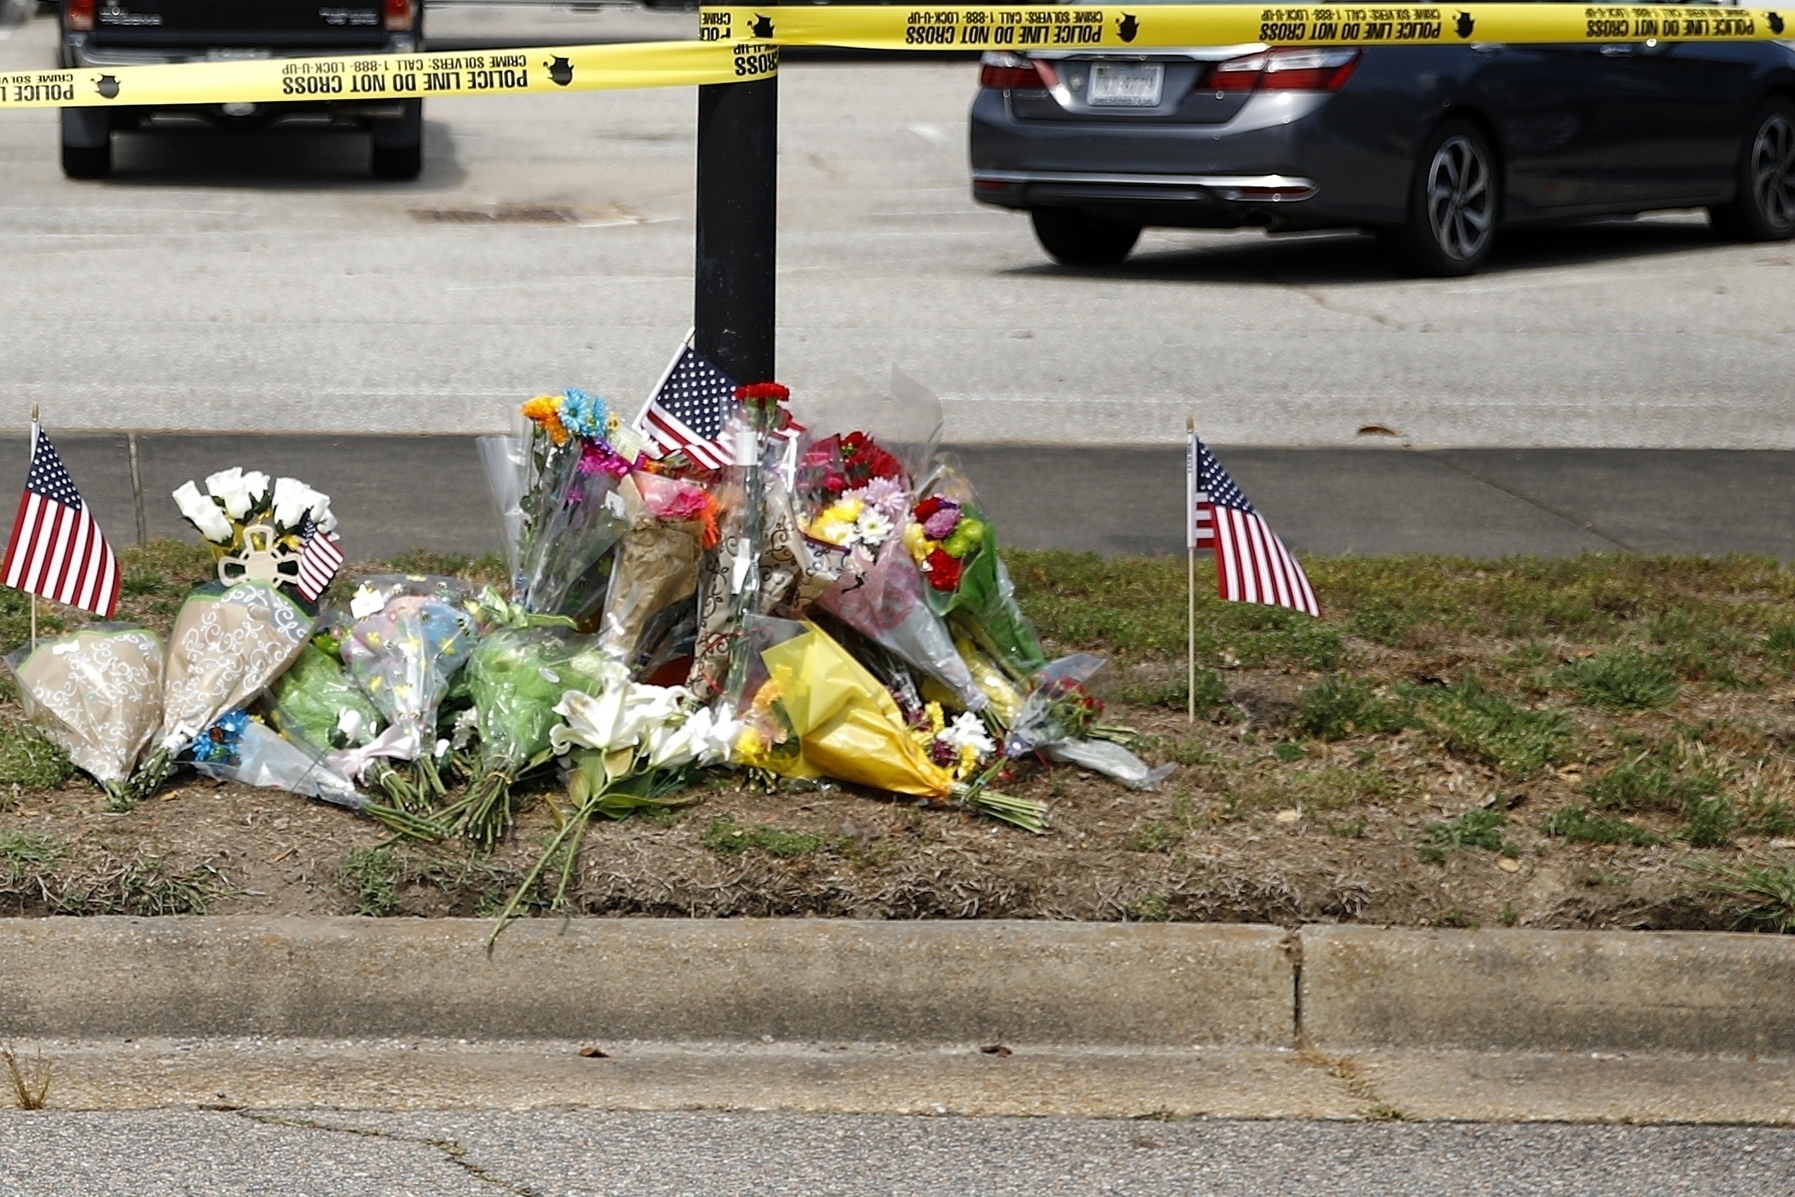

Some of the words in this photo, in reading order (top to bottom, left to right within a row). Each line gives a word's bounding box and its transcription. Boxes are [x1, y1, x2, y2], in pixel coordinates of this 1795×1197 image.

[908, 12, 958, 24] LOCK-U-UP
[963, 12, 994, 24] 1-888-
[999, 12, 1022, 24] CALL
[1025, 12, 1069, 23] SOLVERS:
[1074, 12, 1102, 23] CRIME
[1345, 10, 1365, 21] CALL
[906, 26, 955, 44] CROSS
[961, 26, 989, 44] NOT
[995, 26, 1014, 44] DO
[1019, 26, 1049, 44] LINE
[1053, 25, 1102, 43] POLICE
[1260, 23, 1305, 40] CROSS
[1309, 23, 1337, 40] NOT
[1341, 23, 1359, 40] DO
[1363, 23, 1392, 39] LINE
[1395, 22, 1441, 39] POLICE
[1587, 20, 1628, 37] CROSS
[1633, 20, 1657, 37] NOT
[1663, 20, 1678, 36] DO
[1683, 20, 1709, 36] LINE
[1714, 19, 1754, 35] POLICE
[282, 62, 344, 74] LOCK-U-UP
[350, 60, 389, 72] 1-888-
[395, 59, 423, 71] CALL
[429, 57, 484, 71] SOLVERS:
[490, 55, 526, 70] CRIME
[36, 74, 73, 84] CRIME
[283, 75, 342, 94] CROSS
[350, 74, 384, 93] NOT
[393, 74, 415, 92] DO
[424, 72, 460, 90] LINE
[468, 70, 527, 89] POLICE
[14, 84, 73, 101] POLICE
